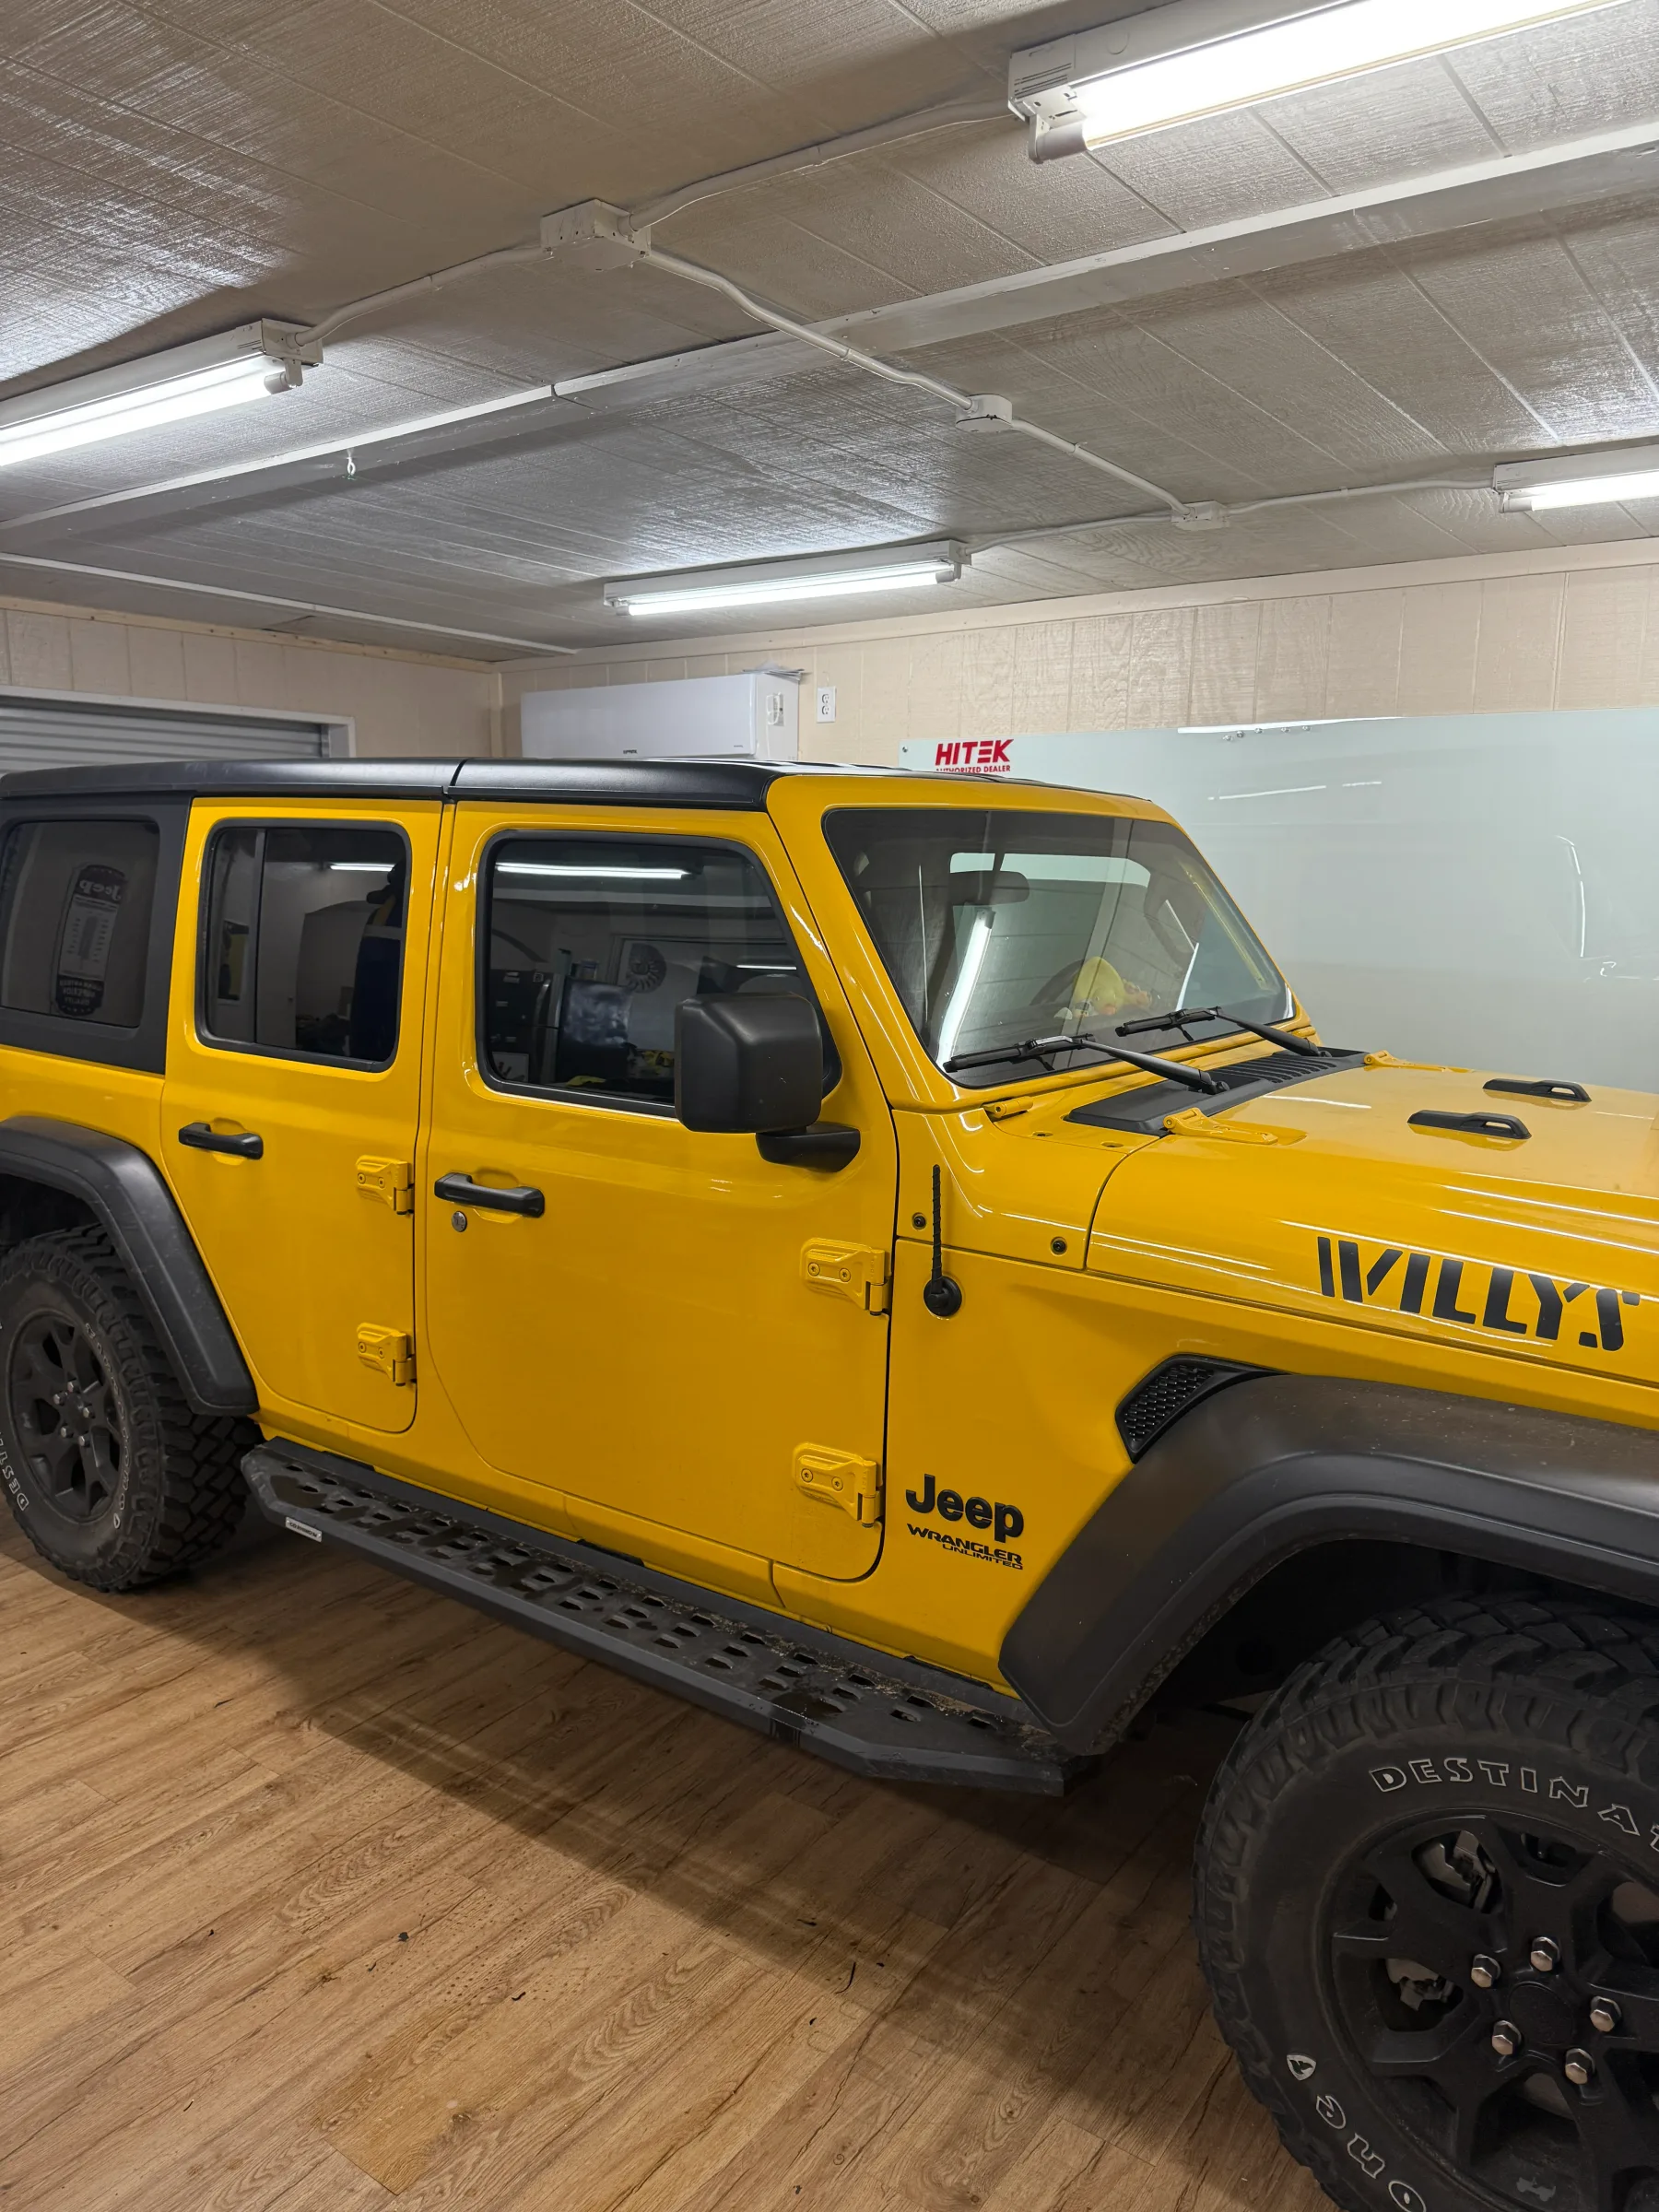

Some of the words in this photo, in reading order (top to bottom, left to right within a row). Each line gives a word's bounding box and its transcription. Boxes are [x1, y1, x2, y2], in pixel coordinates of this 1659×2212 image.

[935, 739, 1014, 766] HITEK
[983, 765, 1011, 773] DEALER
[1317, 1236, 1641, 1351] WILLYS
[905, 1473, 1024, 1544] Jeep
[906, 1523, 1023, 1565] WRANGLER
[942, 1543, 1023, 1571] UNLIMITED
